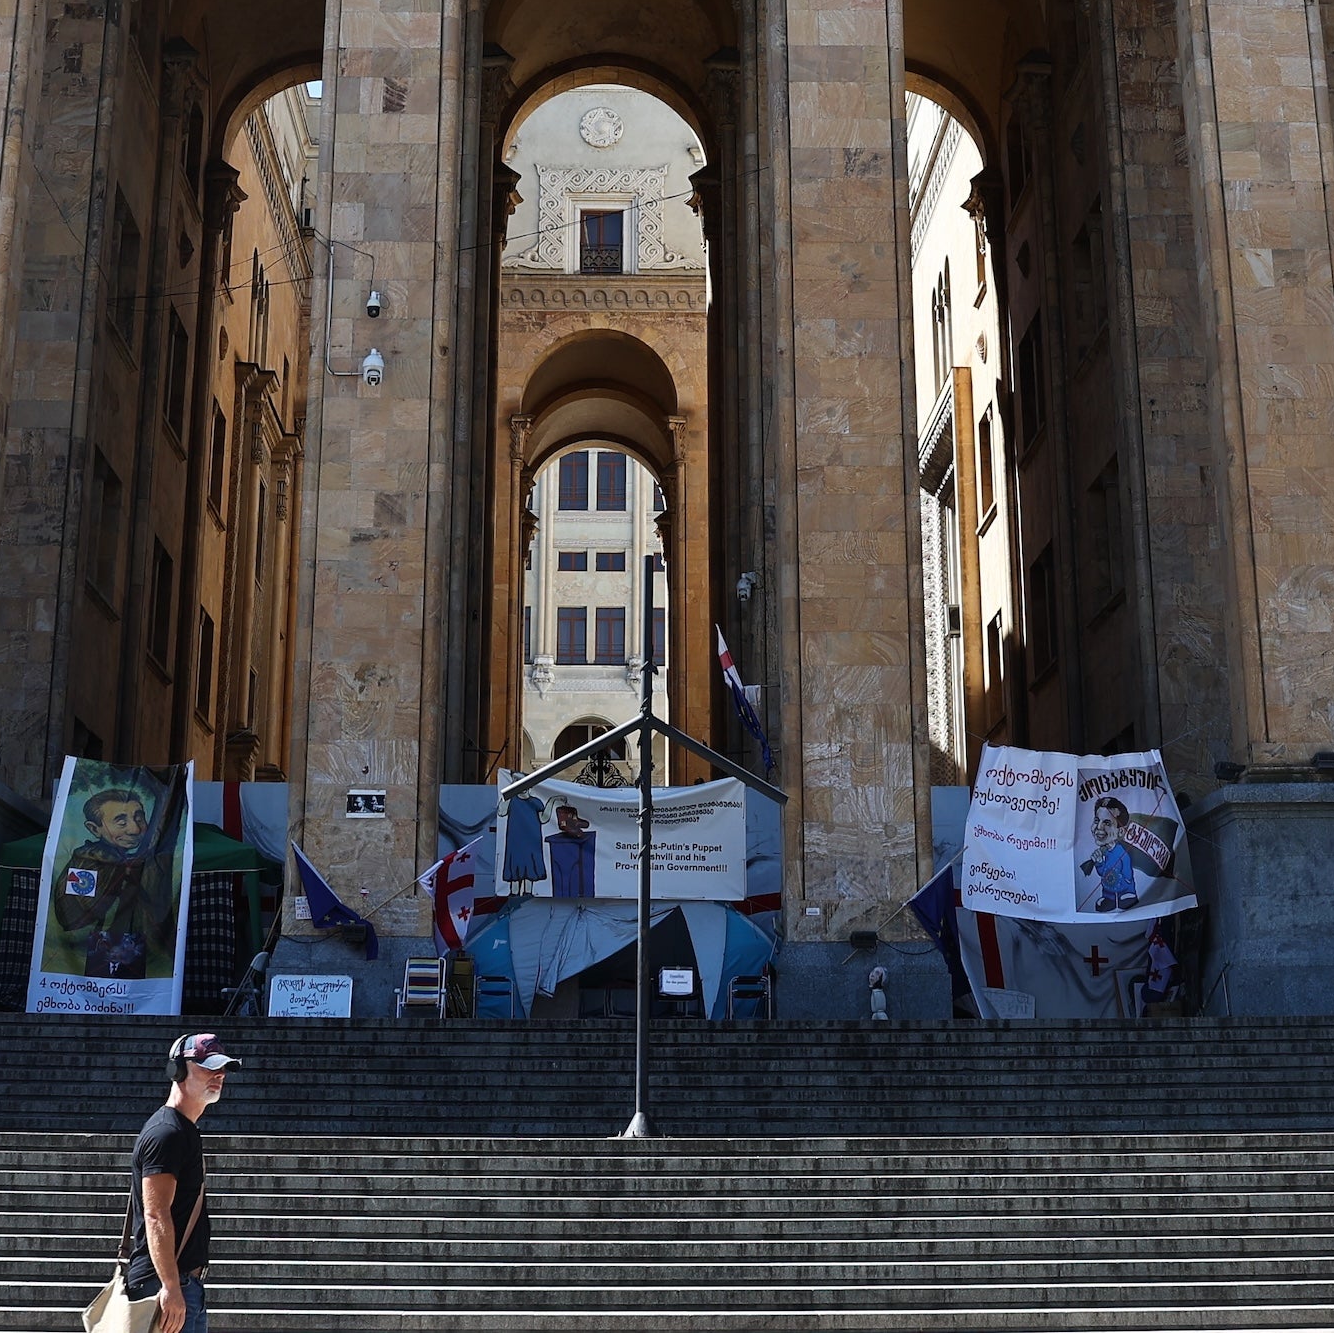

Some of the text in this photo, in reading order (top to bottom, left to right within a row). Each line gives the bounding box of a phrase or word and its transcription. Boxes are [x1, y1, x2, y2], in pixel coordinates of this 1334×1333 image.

[692, 843, 723, 854] Puppet
[675, 853, 691, 862] and
[693, 853, 707, 862] his
[666, 863, 728, 873] Government!!!
[39, 977, 127, 998] 4 ოქტომბერს!
[36, 997, 135, 1014] ემხობა ბიძინა!!!
